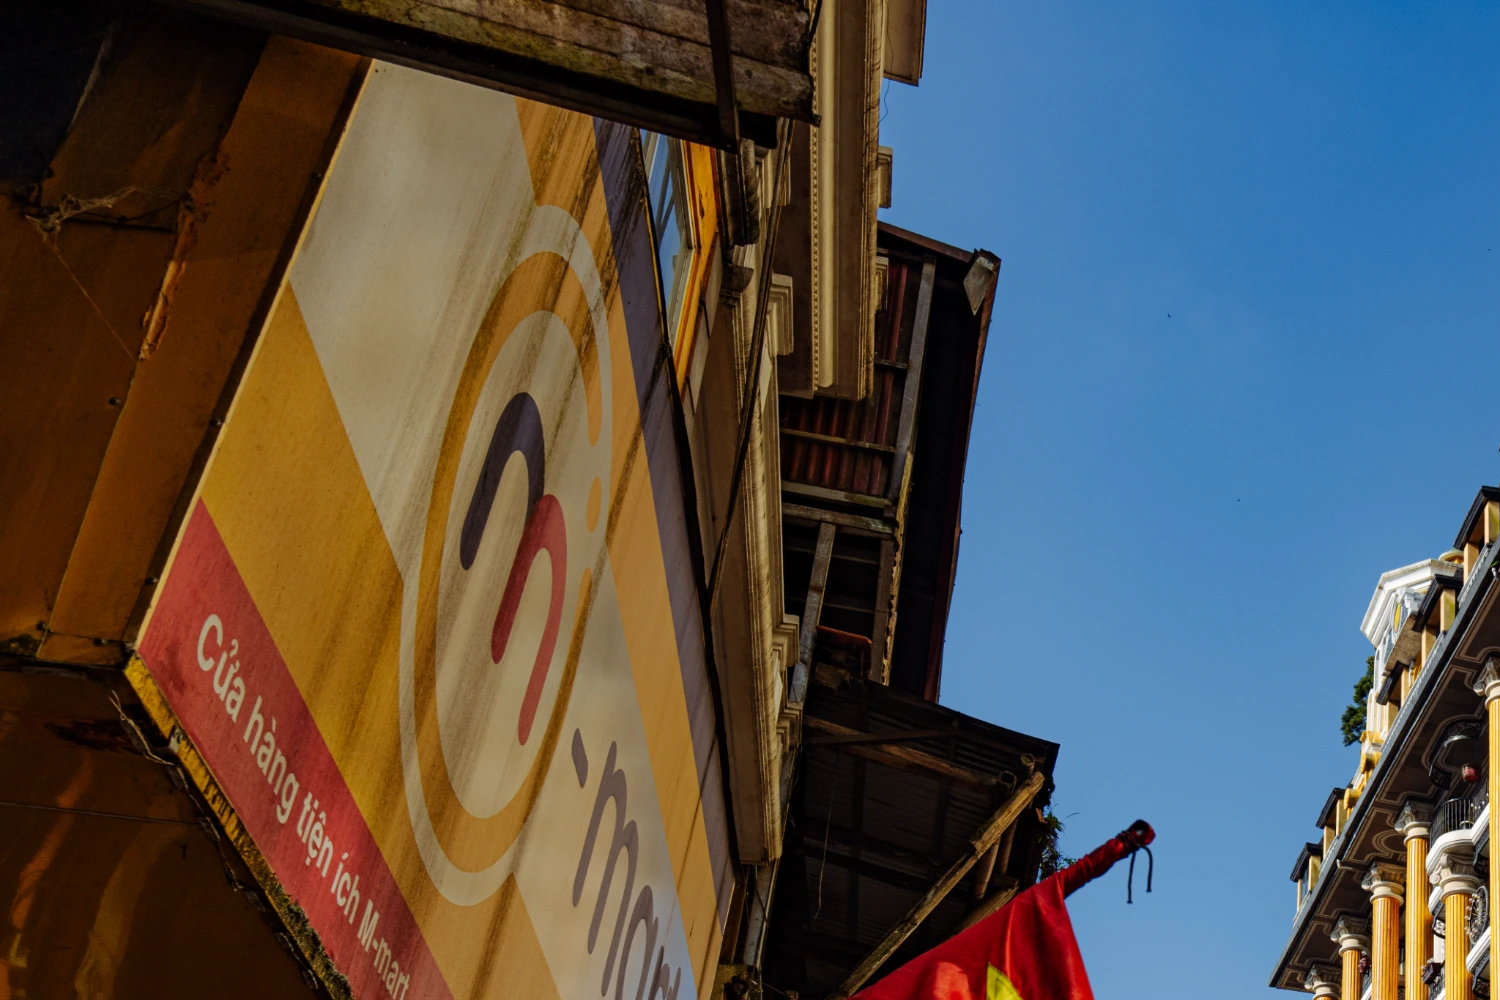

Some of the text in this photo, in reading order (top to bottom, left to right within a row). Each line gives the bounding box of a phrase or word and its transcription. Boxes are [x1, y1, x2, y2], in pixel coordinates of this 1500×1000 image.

[196, 614, 246, 723] Cửa
[242, 695, 299, 825] hàng
[297, 791, 334, 878] tiện
[330, 853, 360, 924] ích
